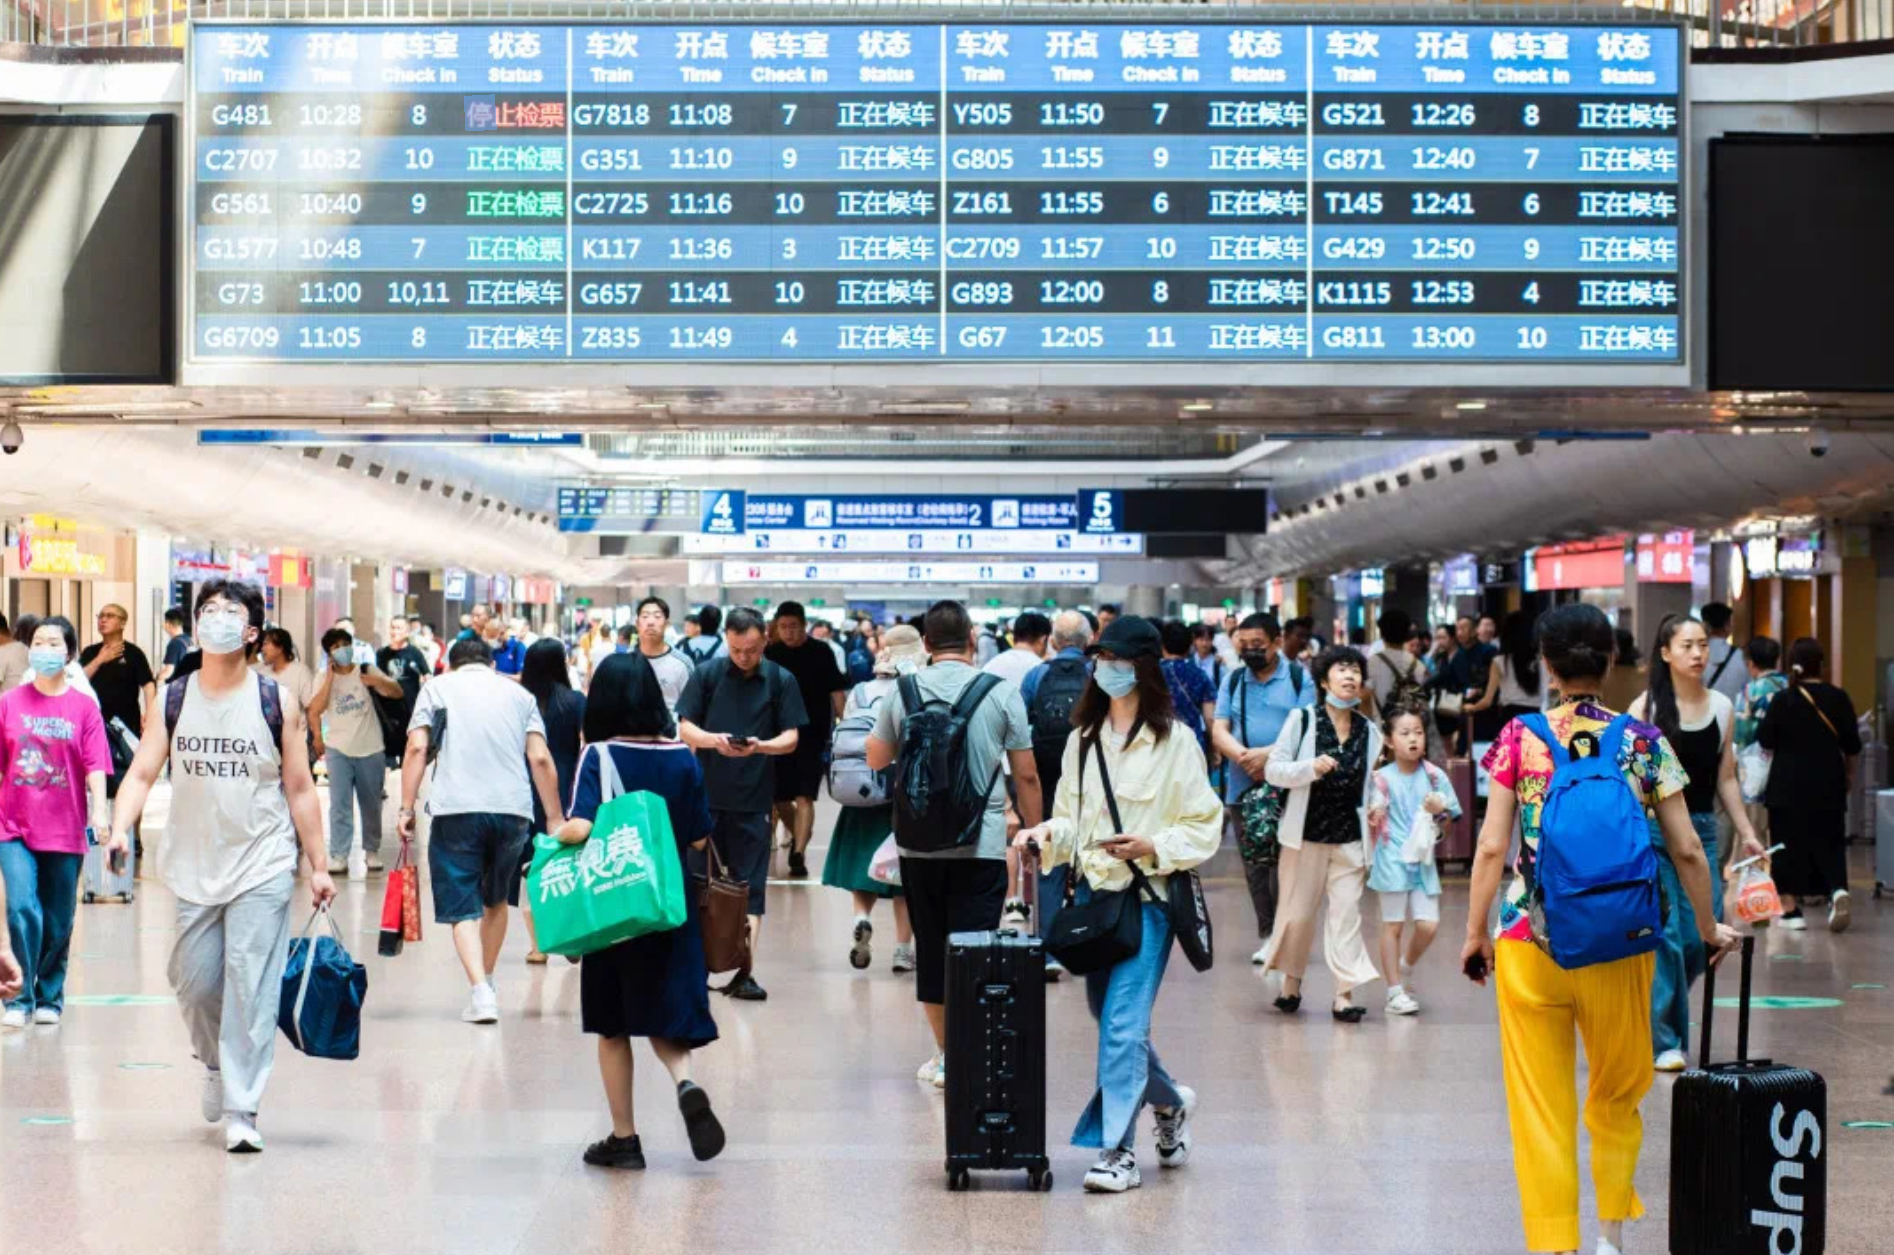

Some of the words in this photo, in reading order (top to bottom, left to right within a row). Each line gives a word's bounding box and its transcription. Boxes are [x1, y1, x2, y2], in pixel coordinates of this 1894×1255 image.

[218, 32, 269, 59] 车次
[488, 32, 541, 59] 状态
[586, 31, 638, 59] 车次
[676, 31, 728, 59] 开点
[750, 31, 829, 59] 候车室
[858, 31, 911, 59] 状态
[956, 31, 1008, 59] 车次
[1046, 31, 1099, 59] 开点
[1120, 31, 1199, 59] 候车室
[1228, 31, 1282, 59] 状态
[1326, 31, 1379, 60] 车次
[1416, 31, 1469, 60] 开点
[1490, 31, 1569, 60] 候车室
[1597, 31, 1650, 60] 状态
[222, 68, 263, 83] Train
[382, 68, 435, 83] Check
[488, 68, 542, 83] Status
[590, 67, 633, 83] Train
[680, 67, 722, 83] Time
[751, 67, 806, 83] Check
[859, 67, 914, 83] Status
[961, 66, 1005, 83] Train
[1051, 66, 1093, 83] Time
[1122, 66, 1178, 83] Check
[1231, 66, 1286, 83] Status
[1333, 67, 1376, 84] Train
[1422, 67, 1464, 84] Time
[1493, 67, 1548, 84] Check
[1601, 67, 1656, 84] Status
[211, 104, 272, 126] G481
[299, 104, 362, 126] 10:28
[411, 104, 427, 125] 8
[467, 103, 564, 127] 停止检票
[574, 104, 650, 125] G7818
[670, 104, 733, 125] 11:08
[782, 103, 798, 125] 7
[839, 102, 934, 126] 正在候车
[954, 103, 1012, 125] Y505
[1042, 102, 1105, 125] 11:50
[1154, 102, 1169, 124] 7
[1211, 102, 1306, 126] 正在候车
[1323, 103, 1386, 125] G521
[1413, 104, 1476, 126] 12:26
[1524, 104, 1540, 126] 8
[1581, 103, 1676, 128] 正在候车
[205, 149, 278, 172] C2707
[298, 148, 362, 171] 10:32
[406, 147, 434, 170] 10
[467, 146, 563, 171] 正在检票
[580, 148, 642, 171] G351
[670, 147, 733, 169] 11:10
[782, 147, 798, 169] 9
[839, 146, 933, 170] 正在候车
[952, 148, 1014, 170] G805
[1041, 147, 1104, 168] 11:55
[1153, 146, 1169, 168] 9
[1210, 146, 1305, 170] 正在候车
[1323, 148, 1386, 170] G871
[1413, 147, 1476, 169] 12:40
[1524, 147, 1540, 170] 7
[1580, 148, 1676, 171] 正在候车
[210, 193, 272, 216] G561
[299, 192, 362, 215] 10:40
[411, 193, 427, 214] 9
[467, 191, 563, 216] 正在检票
[574, 193, 649, 214] C2725
[670, 193, 733, 214] 11:16
[776, 193, 805, 214] 10
[840, 190, 934, 215] 正在候车
[953, 192, 1012, 214] Z161
[1042, 191, 1104, 214] 11:55
[1154, 191, 1169, 213] 6
[1211, 190, 1305, 215] 正在候车
[1325, 192, 1384, 214] T145
[1413, 192, 1475, 214] 12:41
[1524, 193, 1540, 215] 6
[1581, 192, 1676, 217] 正在候车
[203, 238, 278, 260] G1577
[299, 237, 362, 260] 10:48
[411, 237, 427, 259] 7
[467, 236, 563, 261] 正在检票
[583, 238, 641, 259] K117
[670, 237, 732, 259] 11:36
[782, 237, 797, 259] 3
[838, 236, 934, 260] 正在候车
[943, 237, 1021, 259] C2709
[1041, 237, 1104, 259] 11:57
[1147, 237, 1177, 258] 10
[1210, 236, 1306, 259] 正在候车
[1323, 237, 1386, 259] G429
[1413, 237, 1476, 259] 12:50
[1524, 238, 1540, 260] 9
[1581, 237, 1676, 261] 正在候车
[217, 282, 265, 305] G73
[299, 281, 362, 304] 11:00
[387, 281, 450, 307] 10,11
[467, 280, 563, 305] 正在候车
[580, 283, 642, 304] G657
[670, 282, 732, 303] 11:41
[776, 282, 805, 303] 10
[839, 280, 933, 304] 正在候车
[952, 282, 1014, 304] G893
[1042, 280, 1104, 303] 12:00
[1154, 281, 1169, 303] 8
[1211, 279, 1305, 304] 正在候车
[1318, 282, 1391, 304] K1115
[1413, 281, 1475, 303] 12:53
[1524, 282, 1540, 303] 4
[1581, 281, 1676, 305] 正在候车
[203, 326, 280, 349] G6709
[299, 326, 362, 348] 11:05
[411, 326, 426, 348] 8
[467, 325, 563, 350] 正在候车
[581, 326, 641, 349] Z835
[670, 326, 732, 349] 11:49
[781, 327, 798, 348] 4
[838, 325, 934, 349] 正在候车
[959, 326, 1007, 348] G67
[1041, 326, 1104, 348] 12:05
[1147, 326, 1176, 348] 11
[1209, 325, 1306, 349] 正在候车
[1323, 326, 1385, 348] G811
[1413, 326, 1476, 348] 13:00
[1518, 326, 1548, 349] 10
[1581, 326, 1675, 350] 正在候车
[713, 493, 732, 518] 4
[968, 504, 982, 526] 2
[1093, 492, 1113, 518] 5
[177, 736, 259, 755] BOTTEGA
[182, 760, 249, 777] VENETA
